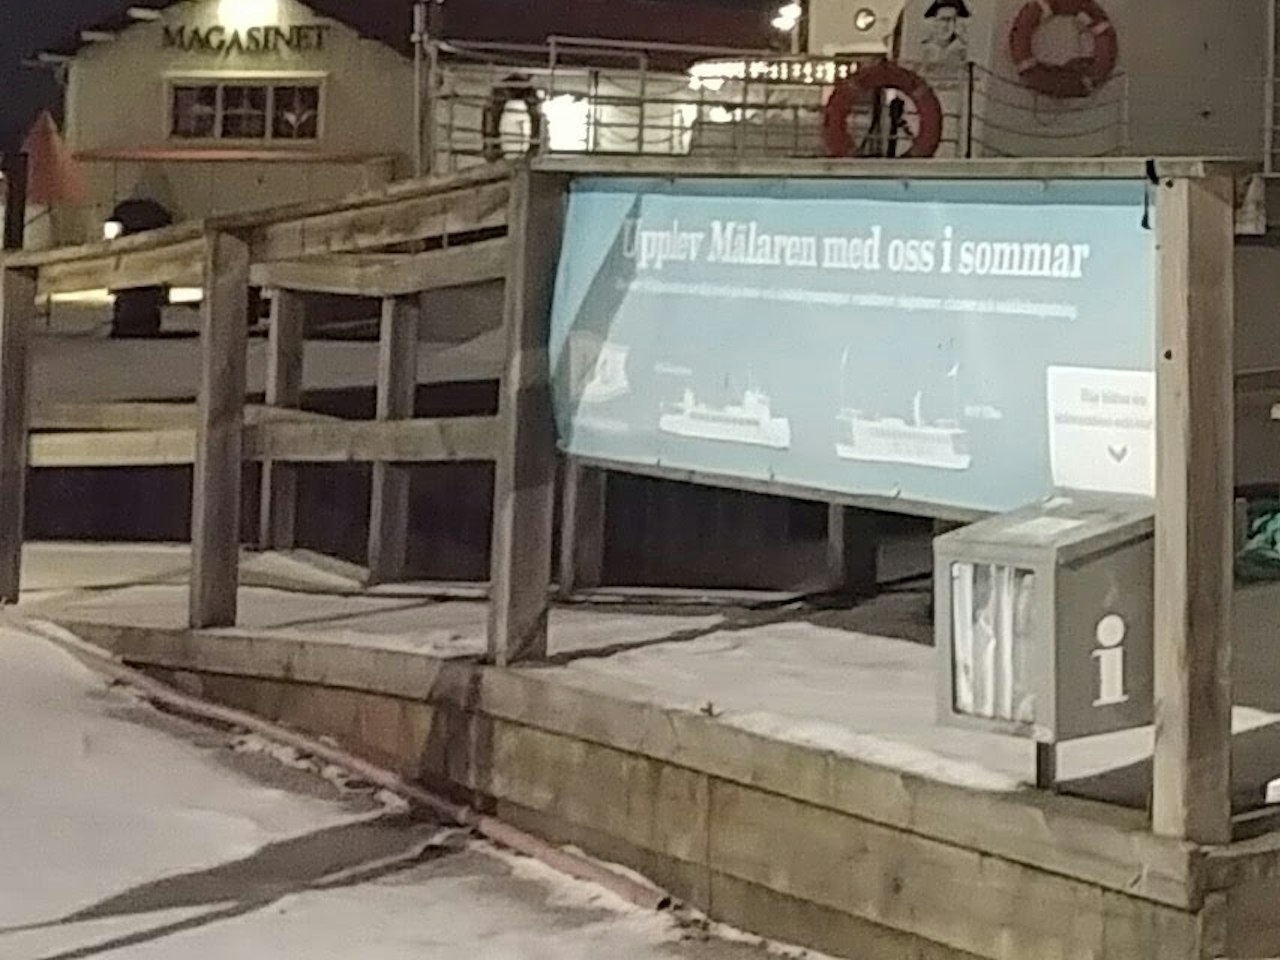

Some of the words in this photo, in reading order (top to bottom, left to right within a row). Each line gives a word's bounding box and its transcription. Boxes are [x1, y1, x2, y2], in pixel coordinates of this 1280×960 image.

[162, 25, 331, 60] MAGASINET
[623, 217, 705, 269] Upplev
[707, 220, 818, 266] Mälaren
[822, 225, 881, 270] med
[888, 237, 935, 273] oss
[940, 225, 953, 274] i
[958, 240, 1090, 279] sommar
